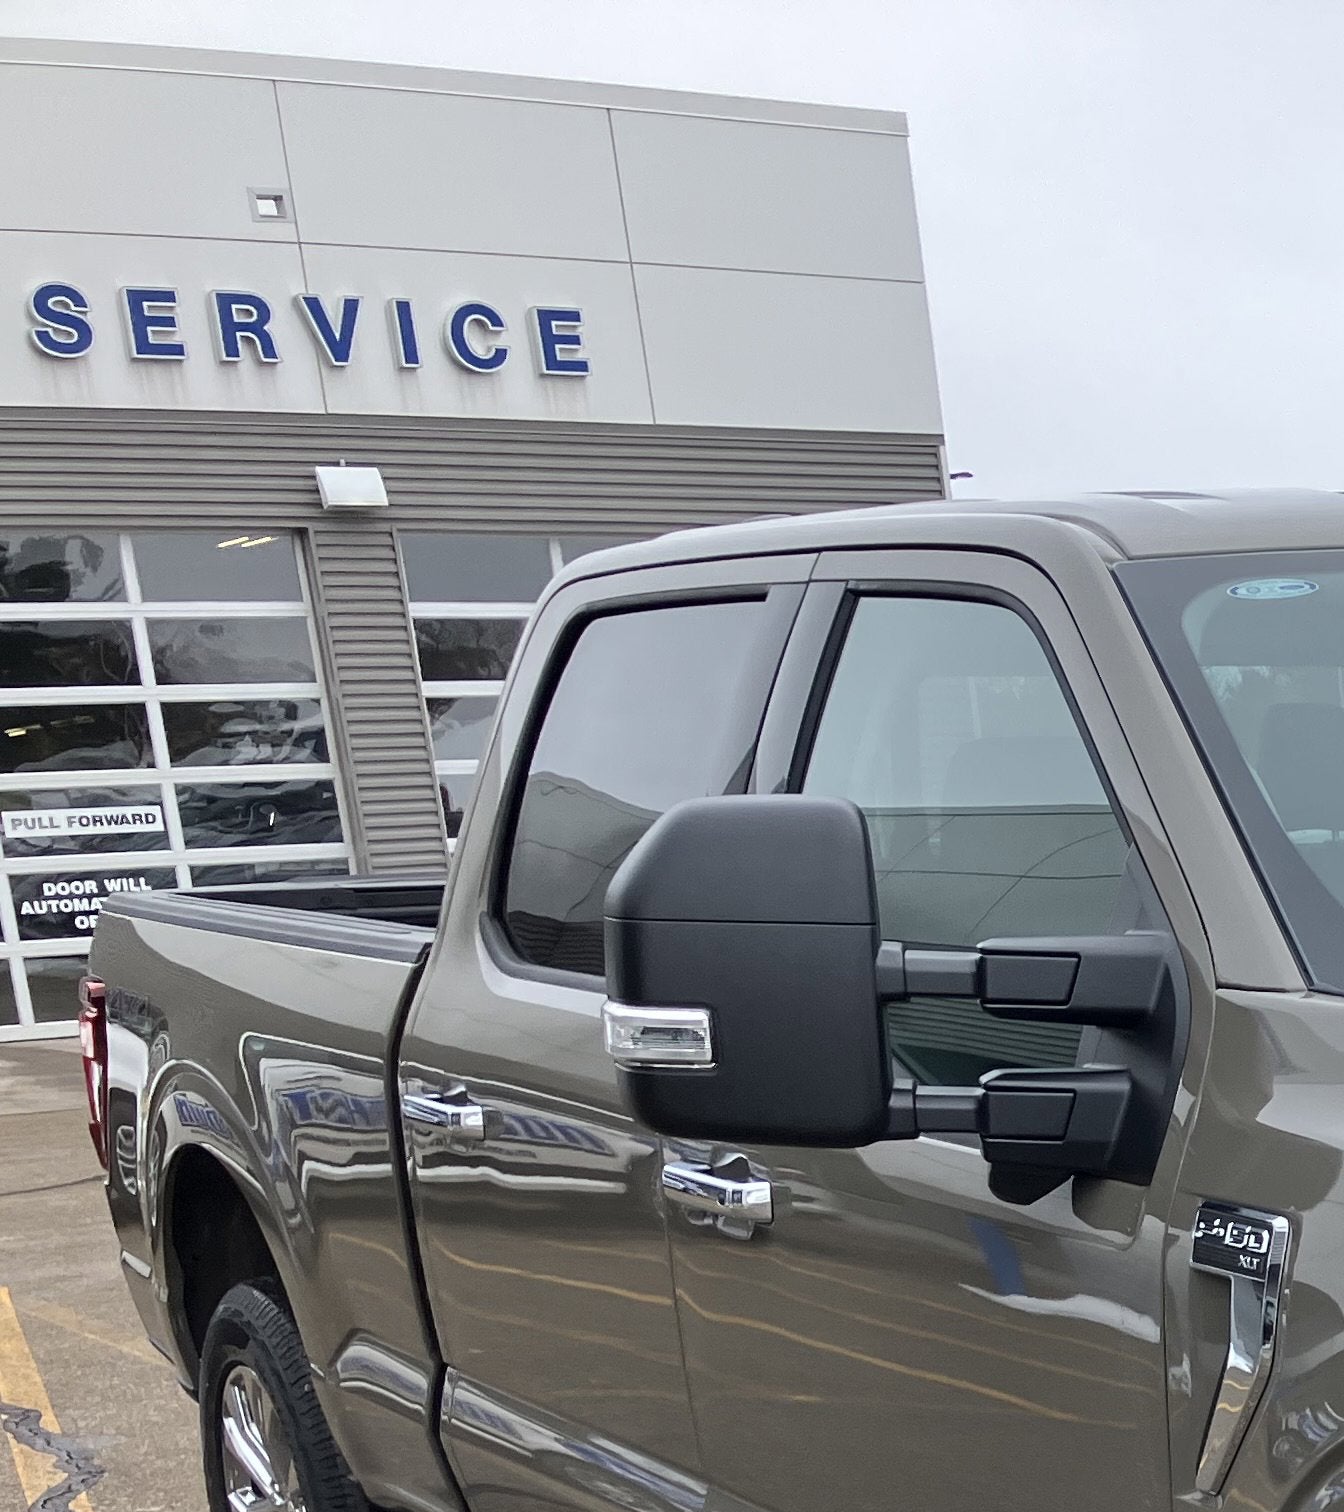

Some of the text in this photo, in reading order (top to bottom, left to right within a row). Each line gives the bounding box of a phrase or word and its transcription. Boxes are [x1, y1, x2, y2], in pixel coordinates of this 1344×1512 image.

[27, 281, 592, 377] SERVICE
[10, 813, 156, 831] PULL FORWARD
[42, 877, 152, 896] DOOR WILL
[20, 897, 108, 915] AUTOMA
[1237, 1254, 1260, 1271] XLT
